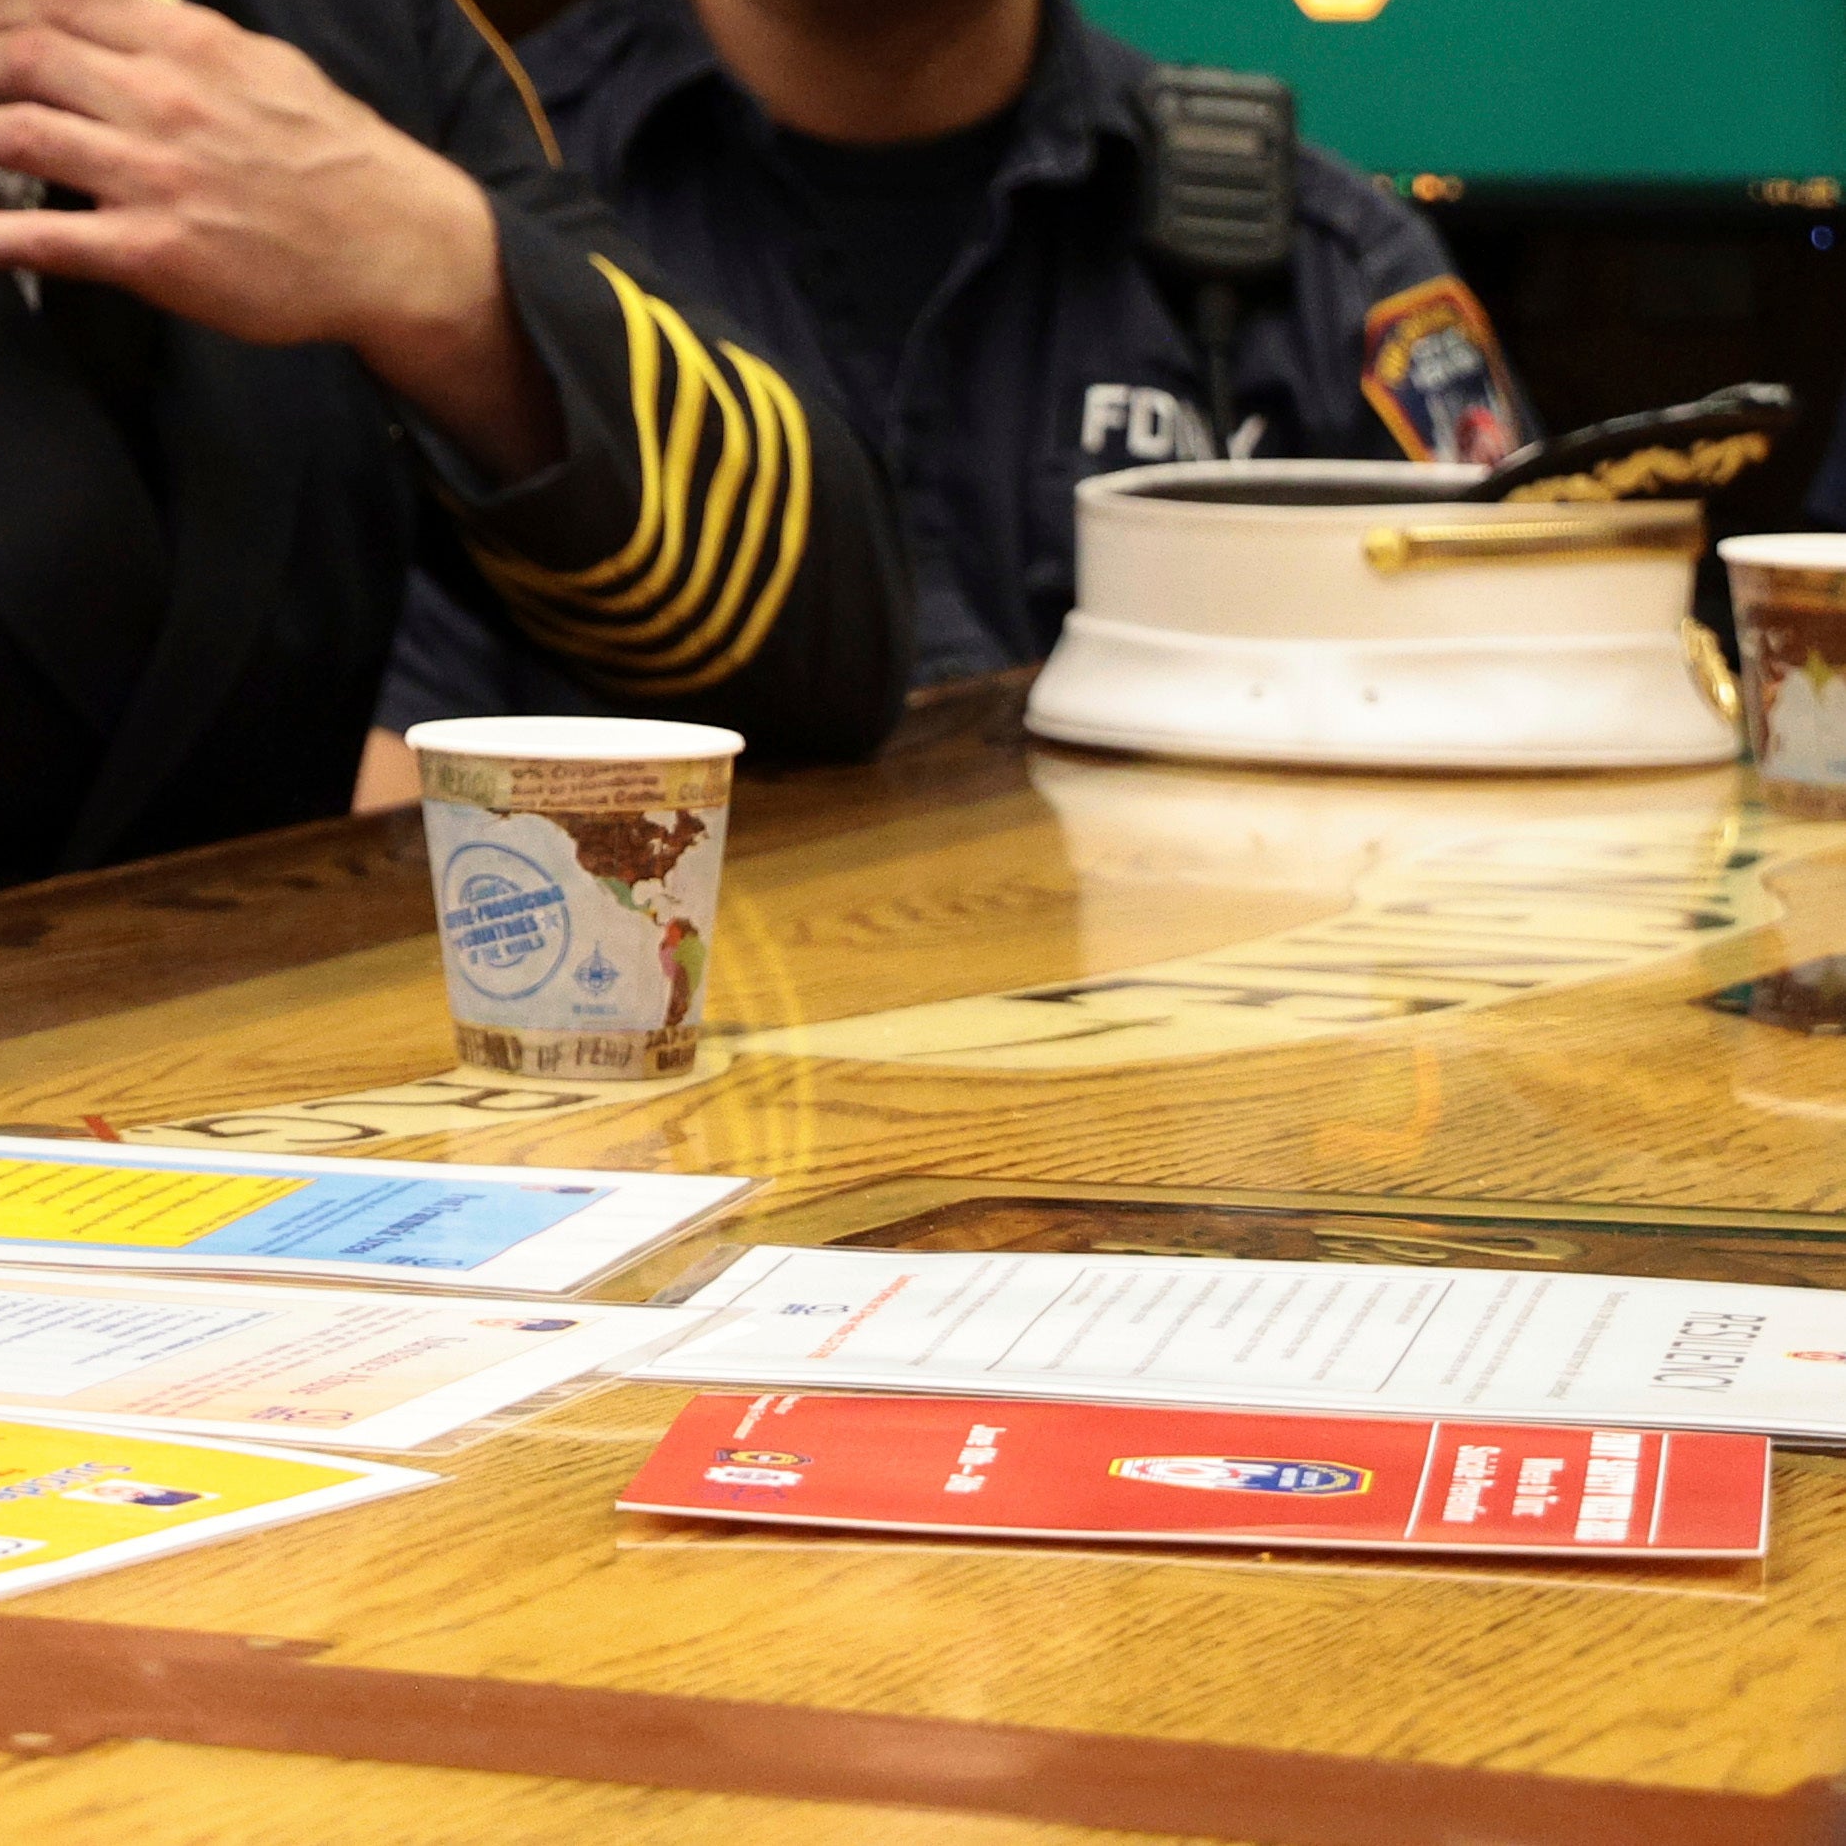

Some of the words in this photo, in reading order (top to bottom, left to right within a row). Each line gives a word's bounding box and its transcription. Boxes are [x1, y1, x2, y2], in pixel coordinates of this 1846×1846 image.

[345, 1335, 472, 1371] Substance
[1646, 1311, 1768, 1393] RESILIENCY
[283, 1371, 382, 1395] Abuse
